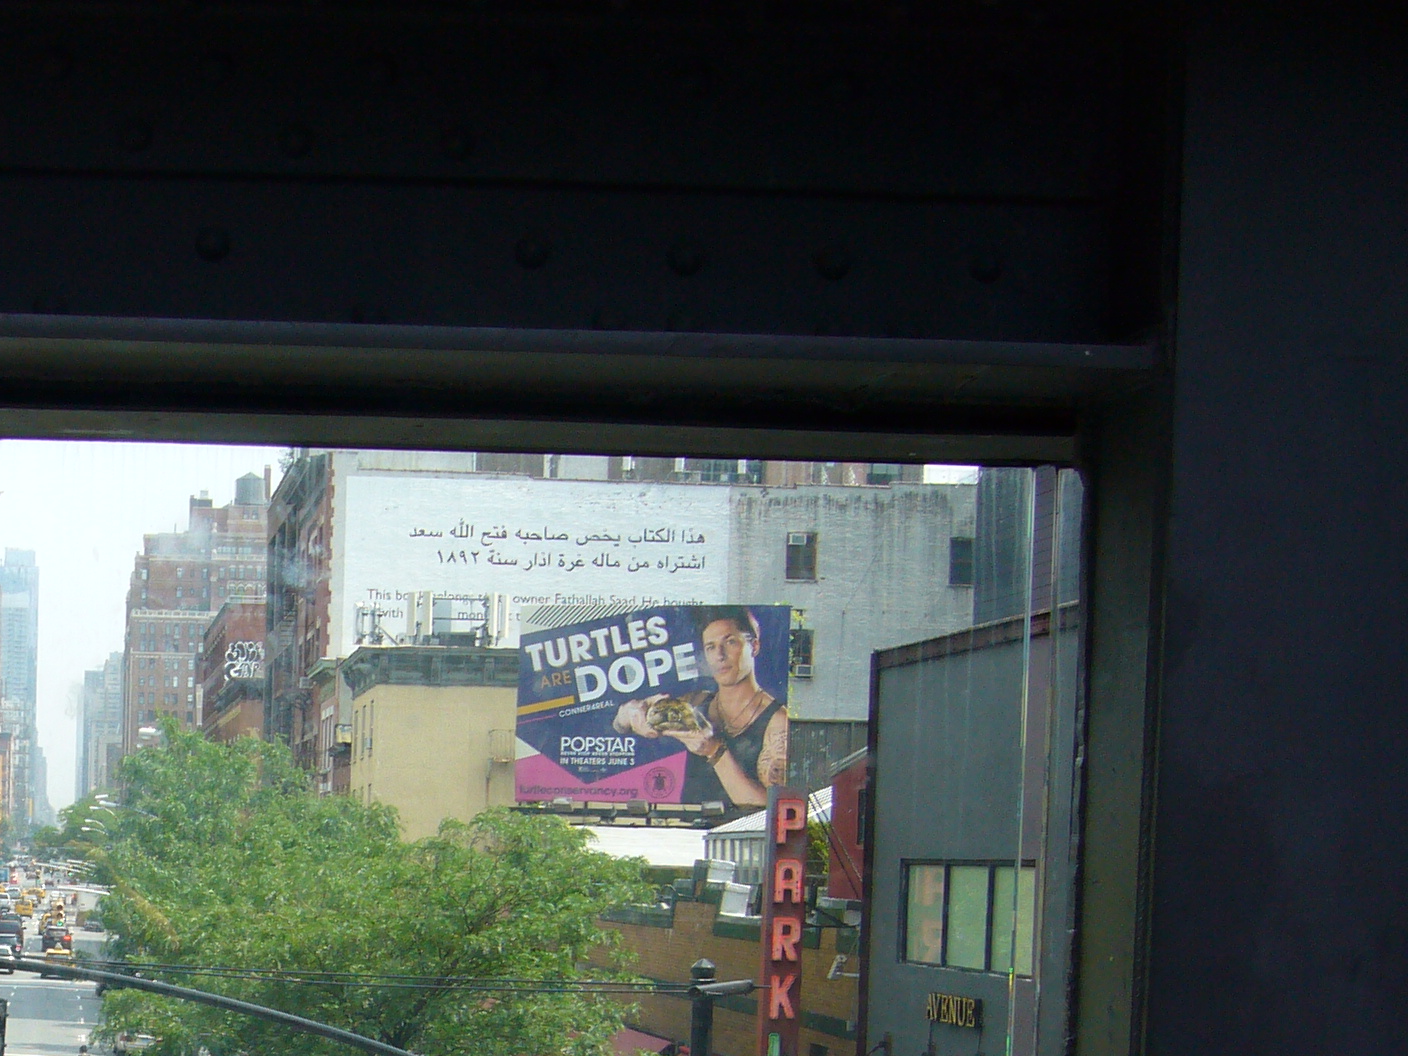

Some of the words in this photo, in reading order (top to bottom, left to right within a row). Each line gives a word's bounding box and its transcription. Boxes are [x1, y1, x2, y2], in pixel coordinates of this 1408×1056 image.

[409, 527, 443, 538] سعد
[480, 525, 508, 547] فتح
[515, 526, 569, 545] صاحبه
[576, 528, 621, 547] يخص
[628, 527, 675, 549] الكتاب
[681, 527, 706, 544] هذا
[487, 549, 518, 566] سنة
[558, 553, 585, 572] غرة
[592, 553, 621, 568] ماله
[627, 557, 650, 572] من
[656, 555, 706, 573] اشتراه
[367, 588, 391, 601] This
[512, 596, 550, 604] owner
[525, 615, 669, 672] TURTLES
[541, 670, 573, 690] ARE
[574, 642, 699, 702] DOPE
[560, 736, 636, 752] POPSTAR
[560, 757, 569, 765] IN
[571, 757, 606, 765] THEATERS
[608, 758, 628, 766] JUNE
[768, 799, 805, 1020] PARK
[925, 992, 975, 1028] AVENUE
